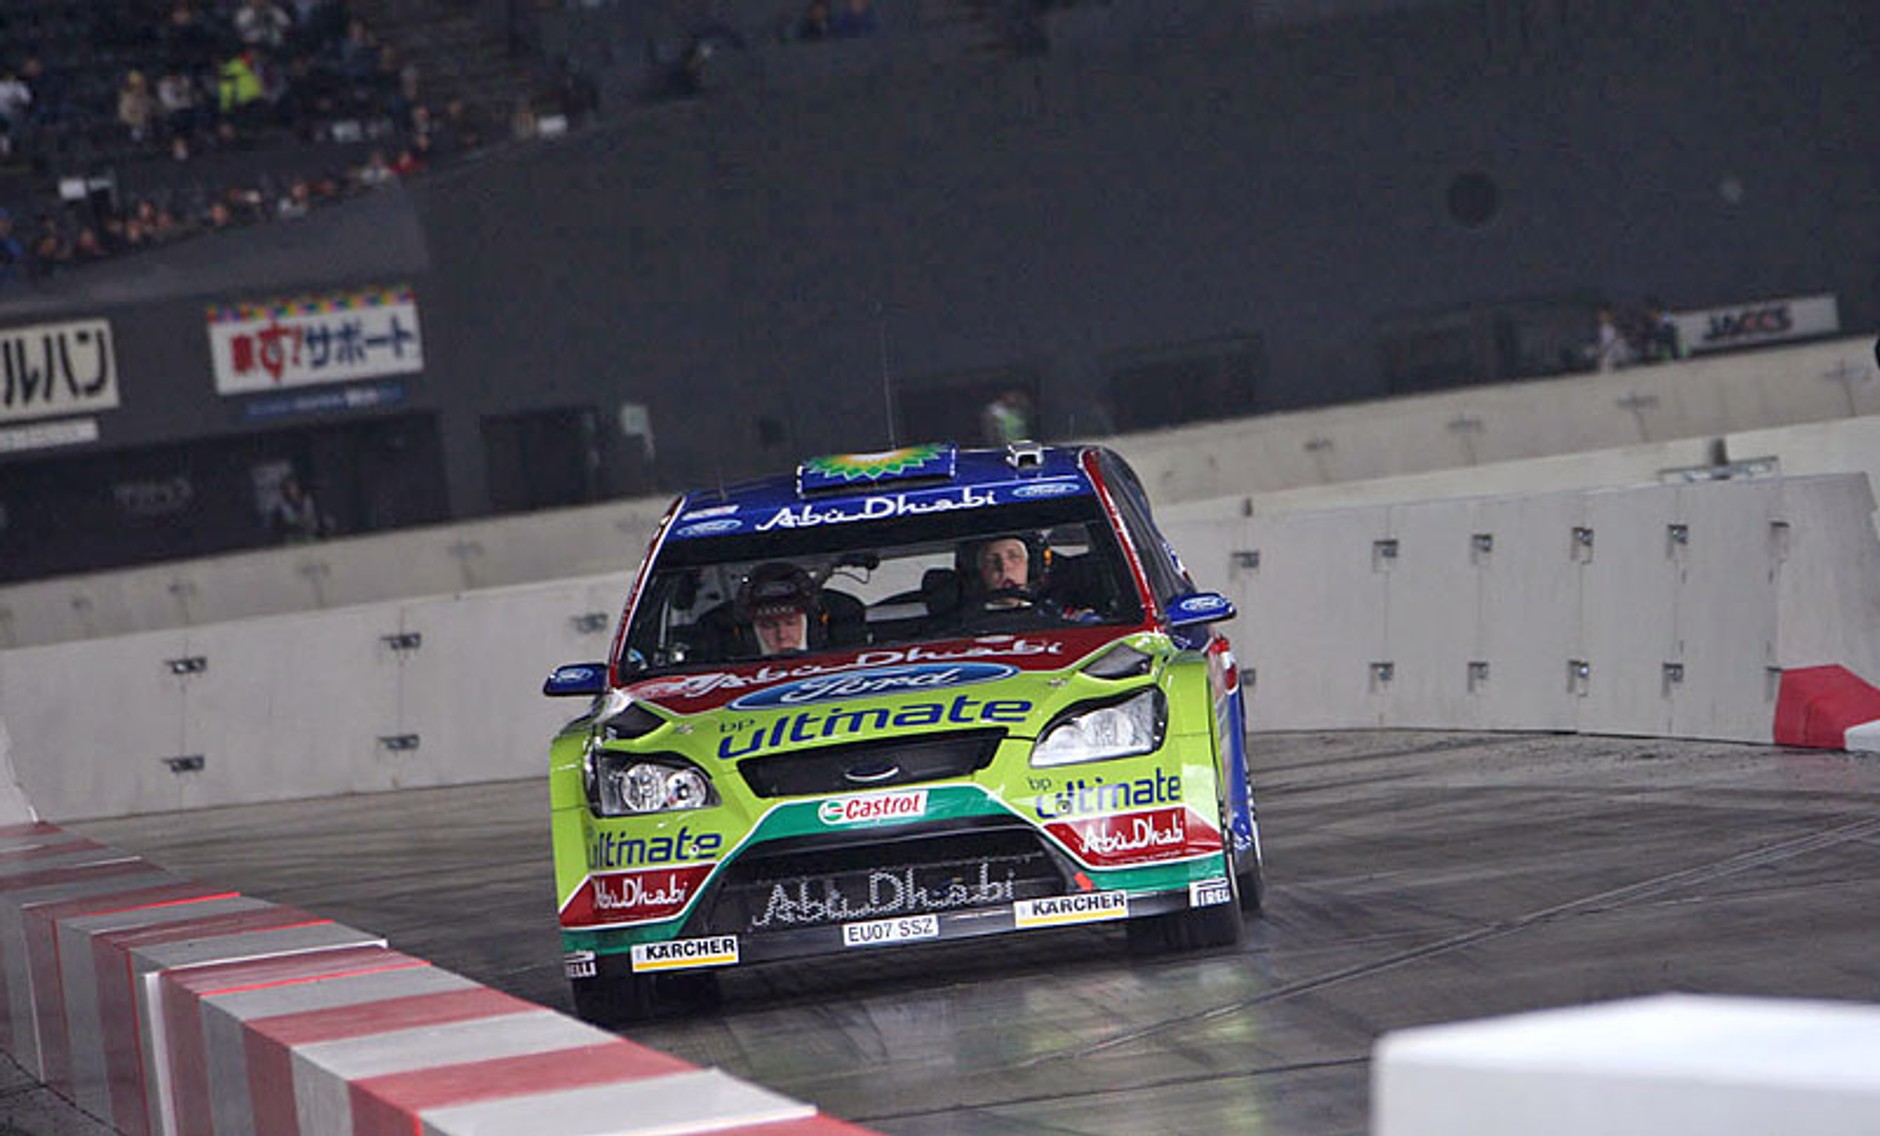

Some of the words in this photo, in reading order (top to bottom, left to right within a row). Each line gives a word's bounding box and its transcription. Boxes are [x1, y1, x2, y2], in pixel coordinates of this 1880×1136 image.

[779, 667, 962, 703] Ford
[717, 695, 1032, 759] ultimate
[846, 794, 920, 819] Castrol
[848, 922, 893, 943] EU07
[899, 917, 935, 938] SSZ
